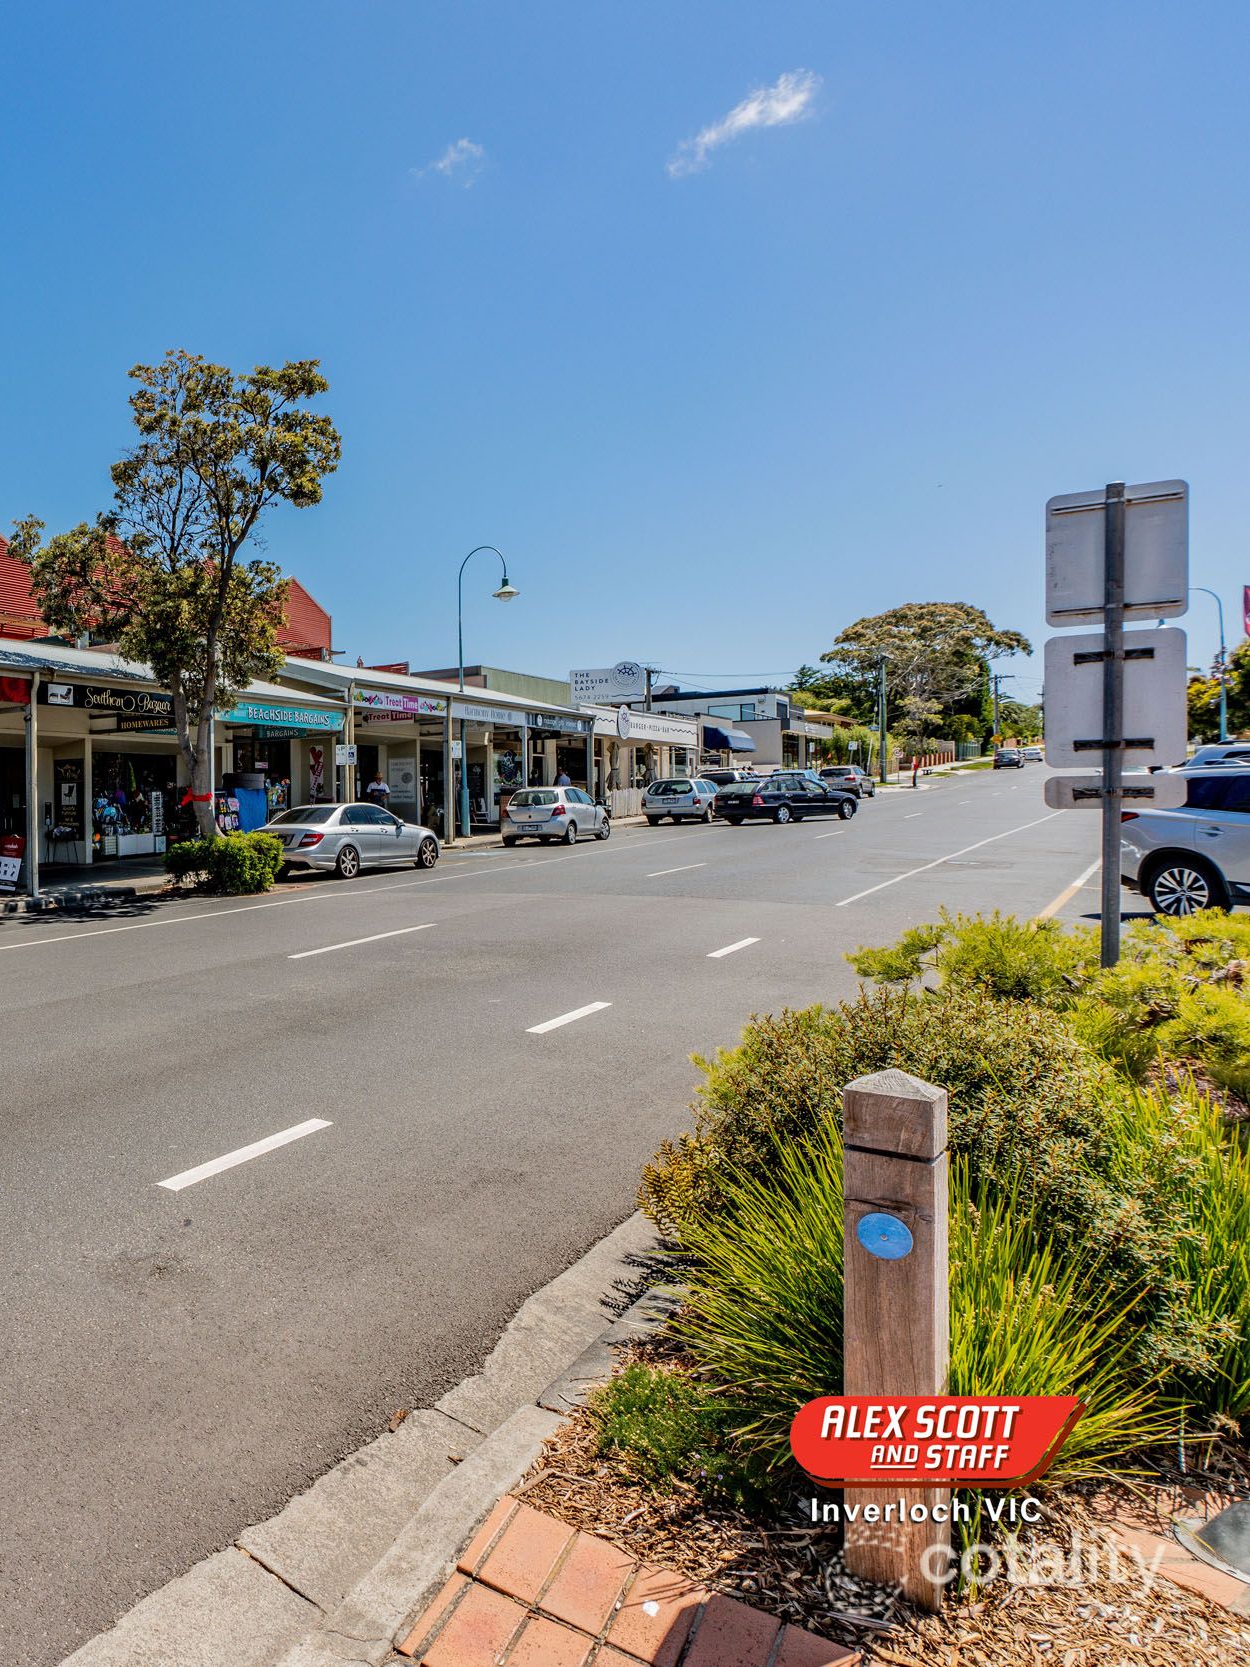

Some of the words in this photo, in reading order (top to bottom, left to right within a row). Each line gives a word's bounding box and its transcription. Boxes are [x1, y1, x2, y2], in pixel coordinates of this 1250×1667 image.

[84, 687, 136, 712] Southern
[137, 692, 172, 714] Bazaar
[385, 695, 403, 707] Treat
[403, 698, 419, 710] Time
[247, 706, 293, 723] BEACHSIDE
[294, 711, 331, 727] BARGAINS
[368, 712, 390, 721] Treat
[391, 711, 413, 720] Time
[120, 718, 170, 730] HOMEWARES
[266, 728, 299, 738] BARGAINS
